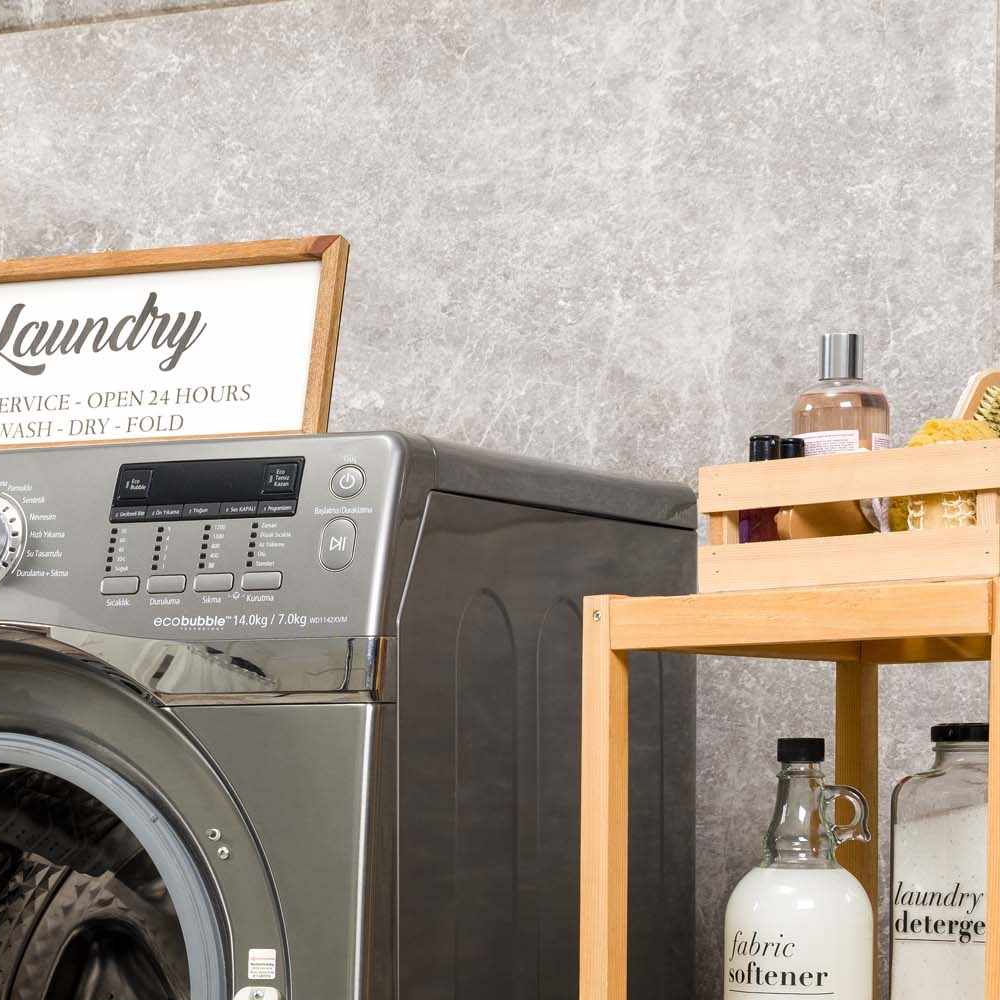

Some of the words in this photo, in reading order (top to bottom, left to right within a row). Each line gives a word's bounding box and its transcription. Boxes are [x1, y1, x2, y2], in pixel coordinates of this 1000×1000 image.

[87, 390, 144, 409] OPEN
[148, 390, 170, 406] 24
[175, 384, 252, 405] HOURS
[68, 417, 110, 436] DRY
[126, 414, 184, 433] FOLD
[233, 614, 268, 628] 14.0kg
[278, 613, 307, 627] 7.0kg
[894, 881, 984, 914] laundry
[728, 930, 796, 962] fabric
[728, 961, 829, 986] softener
